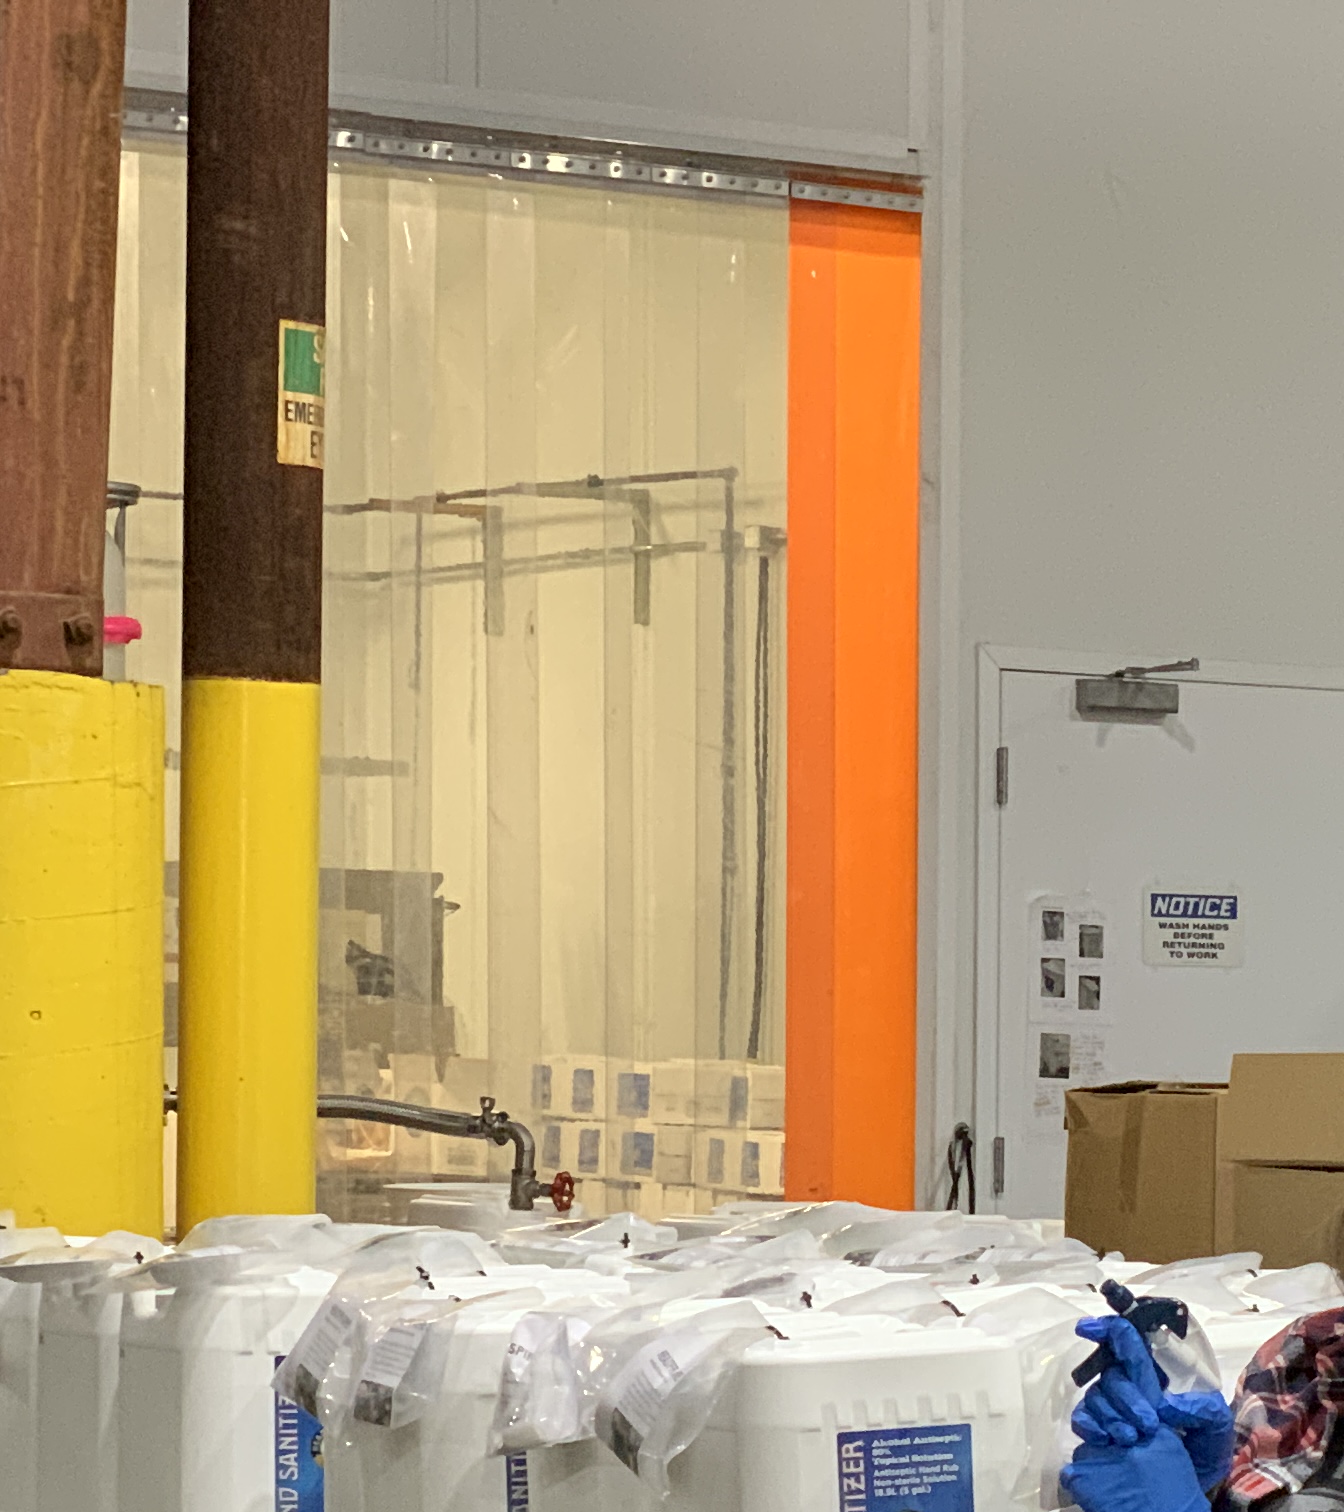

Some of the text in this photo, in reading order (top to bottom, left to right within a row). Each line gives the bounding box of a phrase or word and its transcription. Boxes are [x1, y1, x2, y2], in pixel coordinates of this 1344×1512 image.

[1154, 897, 1235, 916] NOTICE
[1193, 923, 1229, 931] HANDS
[1173, 932, 1214, 940] BEFORE
[1162, 941, 1225, 950] RETURNING
[1169, 951, 1218, 959] TO WORK
